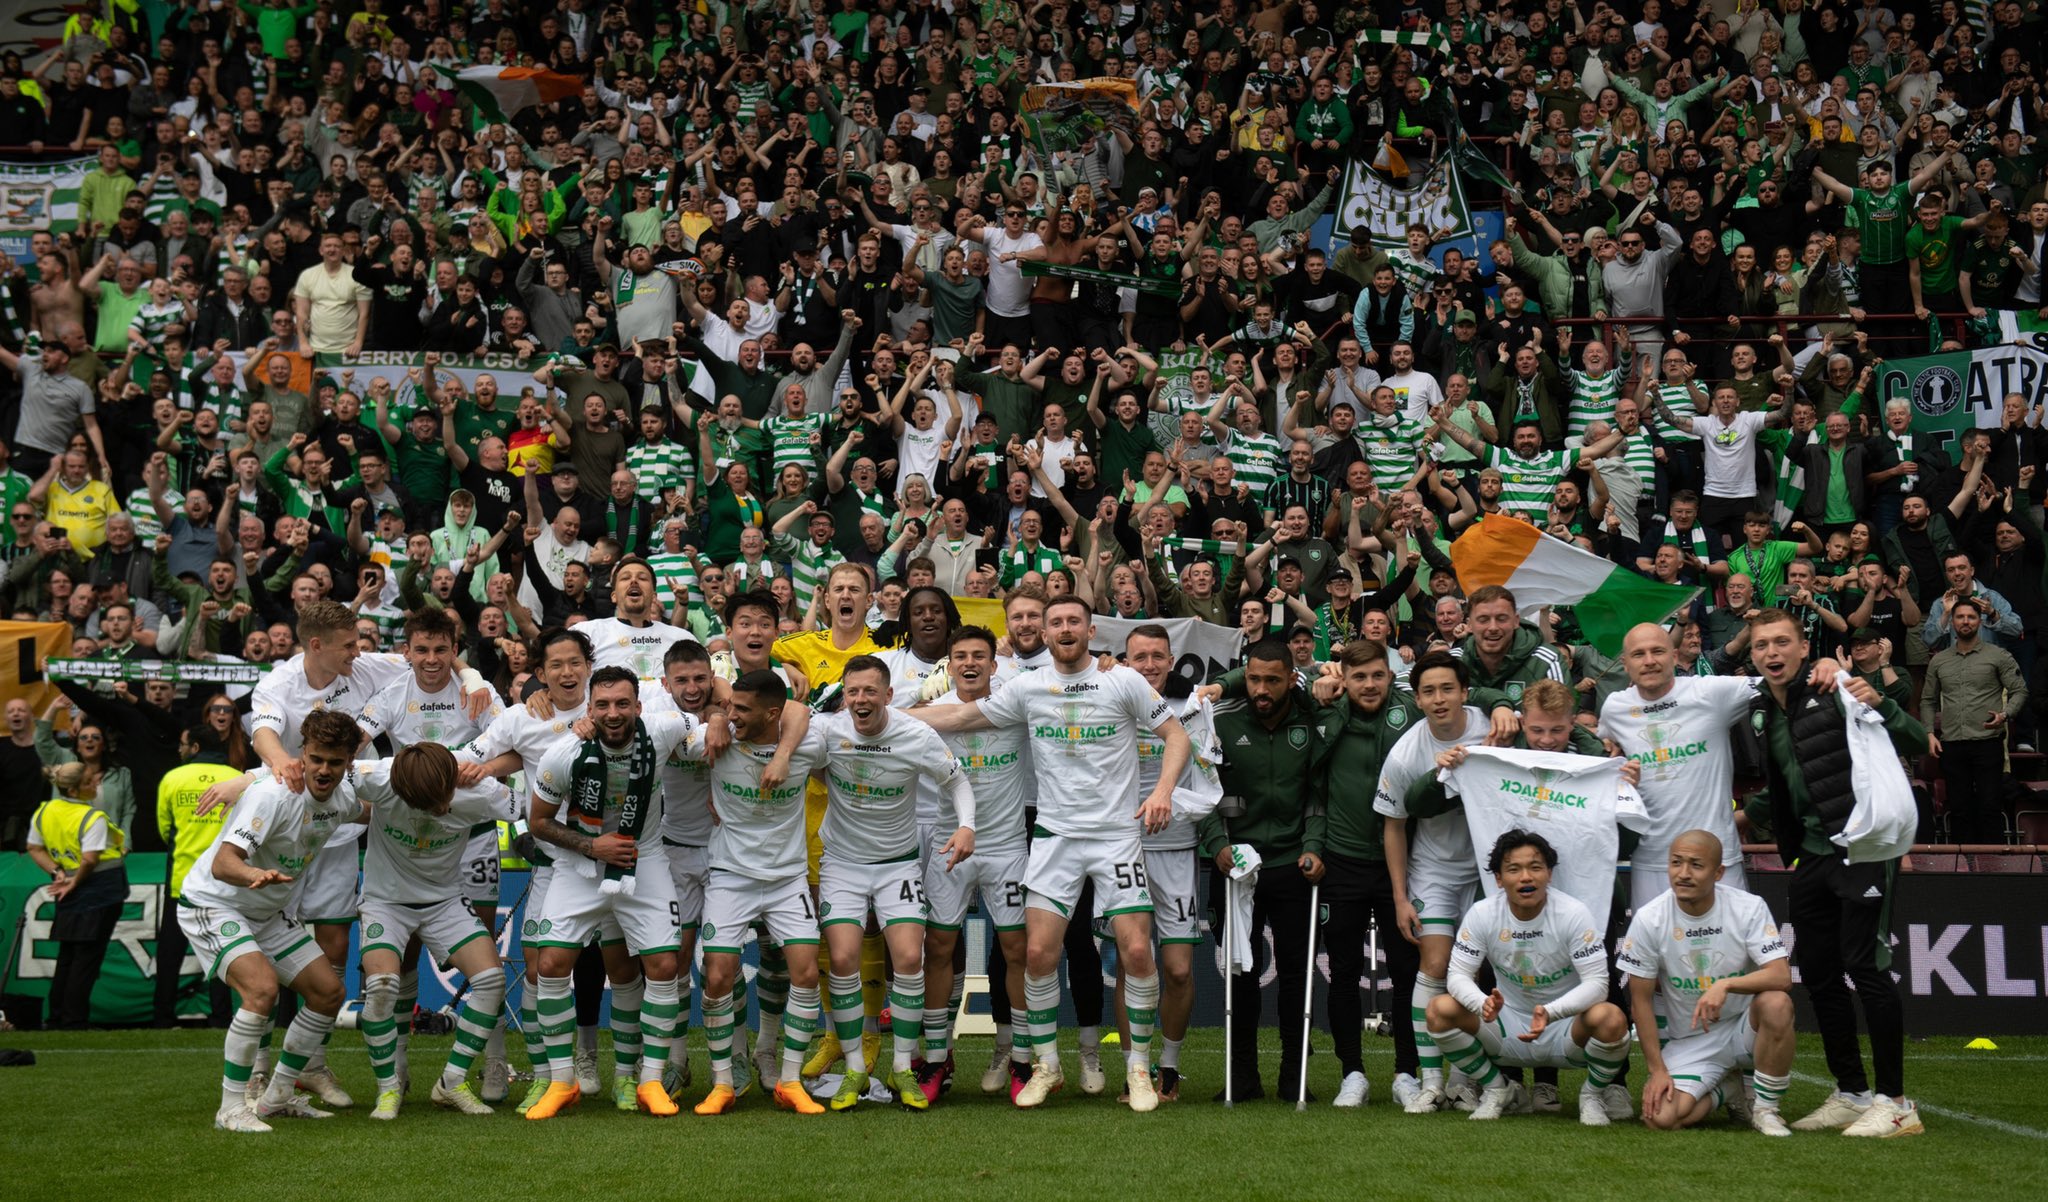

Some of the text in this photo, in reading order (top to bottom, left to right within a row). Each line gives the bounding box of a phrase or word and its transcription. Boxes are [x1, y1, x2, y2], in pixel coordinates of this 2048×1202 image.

[680, 261, 700, 274] SING
[341, 350, 419, 366] DERRY
[483, 352, 529, 371] CSC
[1521, 475, 1547, 483] dafabet
[631, 636, 662, 644] dafabet
[1064, 683, 1099, 693] dafabet
[420, 702, 455, 712] dafabet
[1643, 700, 1678, 714] dafabet
[855, 744, 891, 754] dafabet
[585, 779, 602, 812] 2023
[620, 795, 638, 828] 2023
[472, 858, 499, 885] 33
[1114, 863, 1147, 889] 56
[669, 901, 681, 927] 9
[1175, 896, 1197, 922] 14
[1511, 930, 1544, 940] dafabet
[1686, 926, 1723, 939] dafabet
